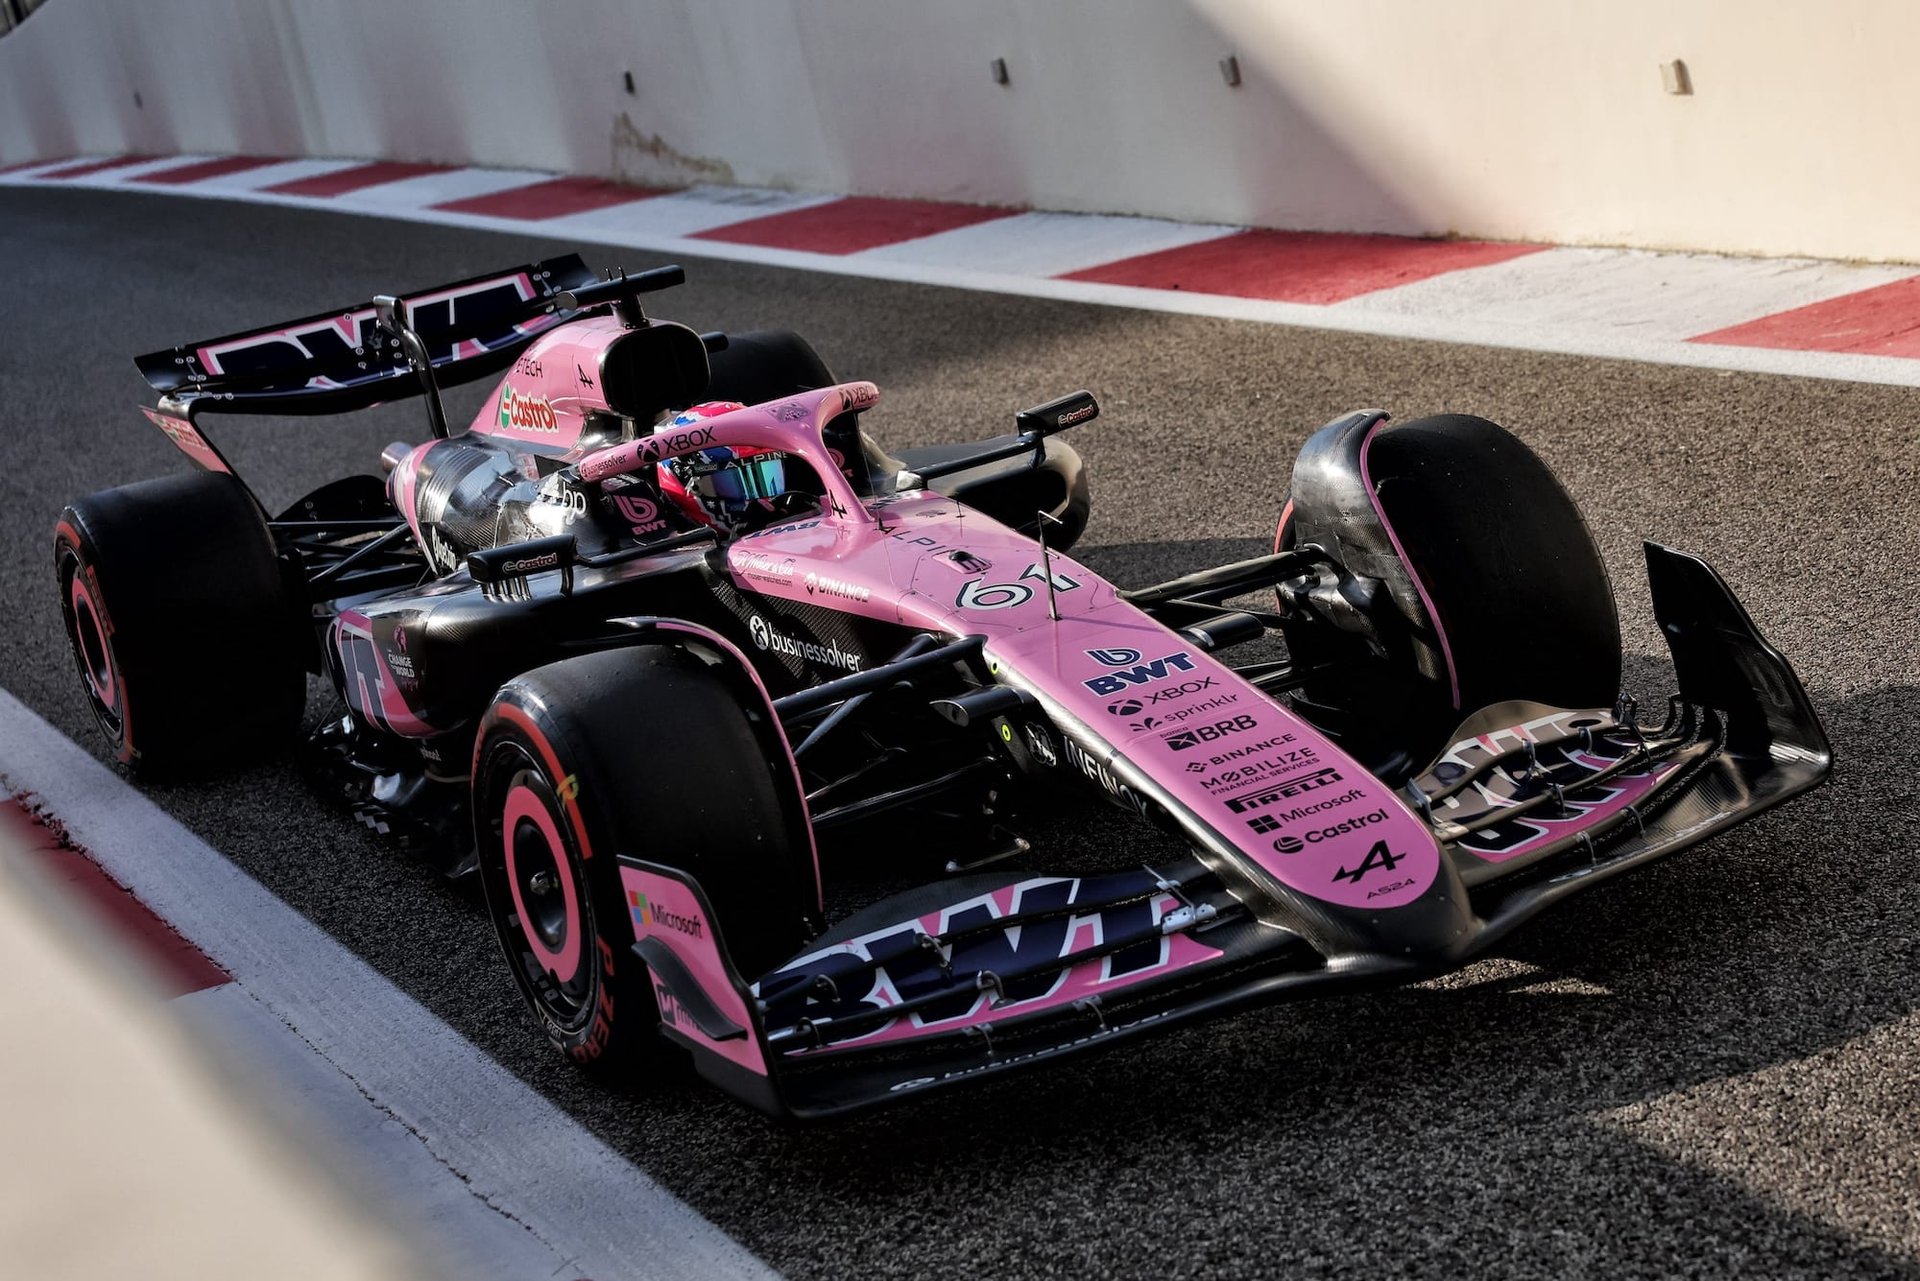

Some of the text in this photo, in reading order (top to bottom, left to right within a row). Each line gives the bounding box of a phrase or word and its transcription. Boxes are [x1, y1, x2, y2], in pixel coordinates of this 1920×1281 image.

[510, 388, 559, 433] Castrol
[662, 426, 718, 455] XBOX
[725, 450, 788, 470] ALPINE
[631, 519, 667, 536] BWT
[873, 517, 957, 554] ALPI
[515, 552, 558, 572] Castrol
[818, 577, 871, 603] BINANCE
[955, 562, 1083, 611] 61
[768, 621, 861, 672] businessolver
[1081, 651, 1198, 698] BWT
[1144, 676, 1221, 705] XBOX
[1164, 692, 1238, 723] sprinklr
[1159, 726, 1189, 739] banco
[1198, 714, 1258, 742] BRB
[1209, 733, 1297, 766] BINANCE
[1210, 757, 1321, 796] FINANCIAL SERVICES
[1224, 767, 1344, 814] PIRELLI
[1279, 788, 1367, 823] Microsoft
[1305, 808, 1389, 844] Castrol
[1366, 878, 1416, 900] A524
[650, 902, 703, 939] Microsoft
